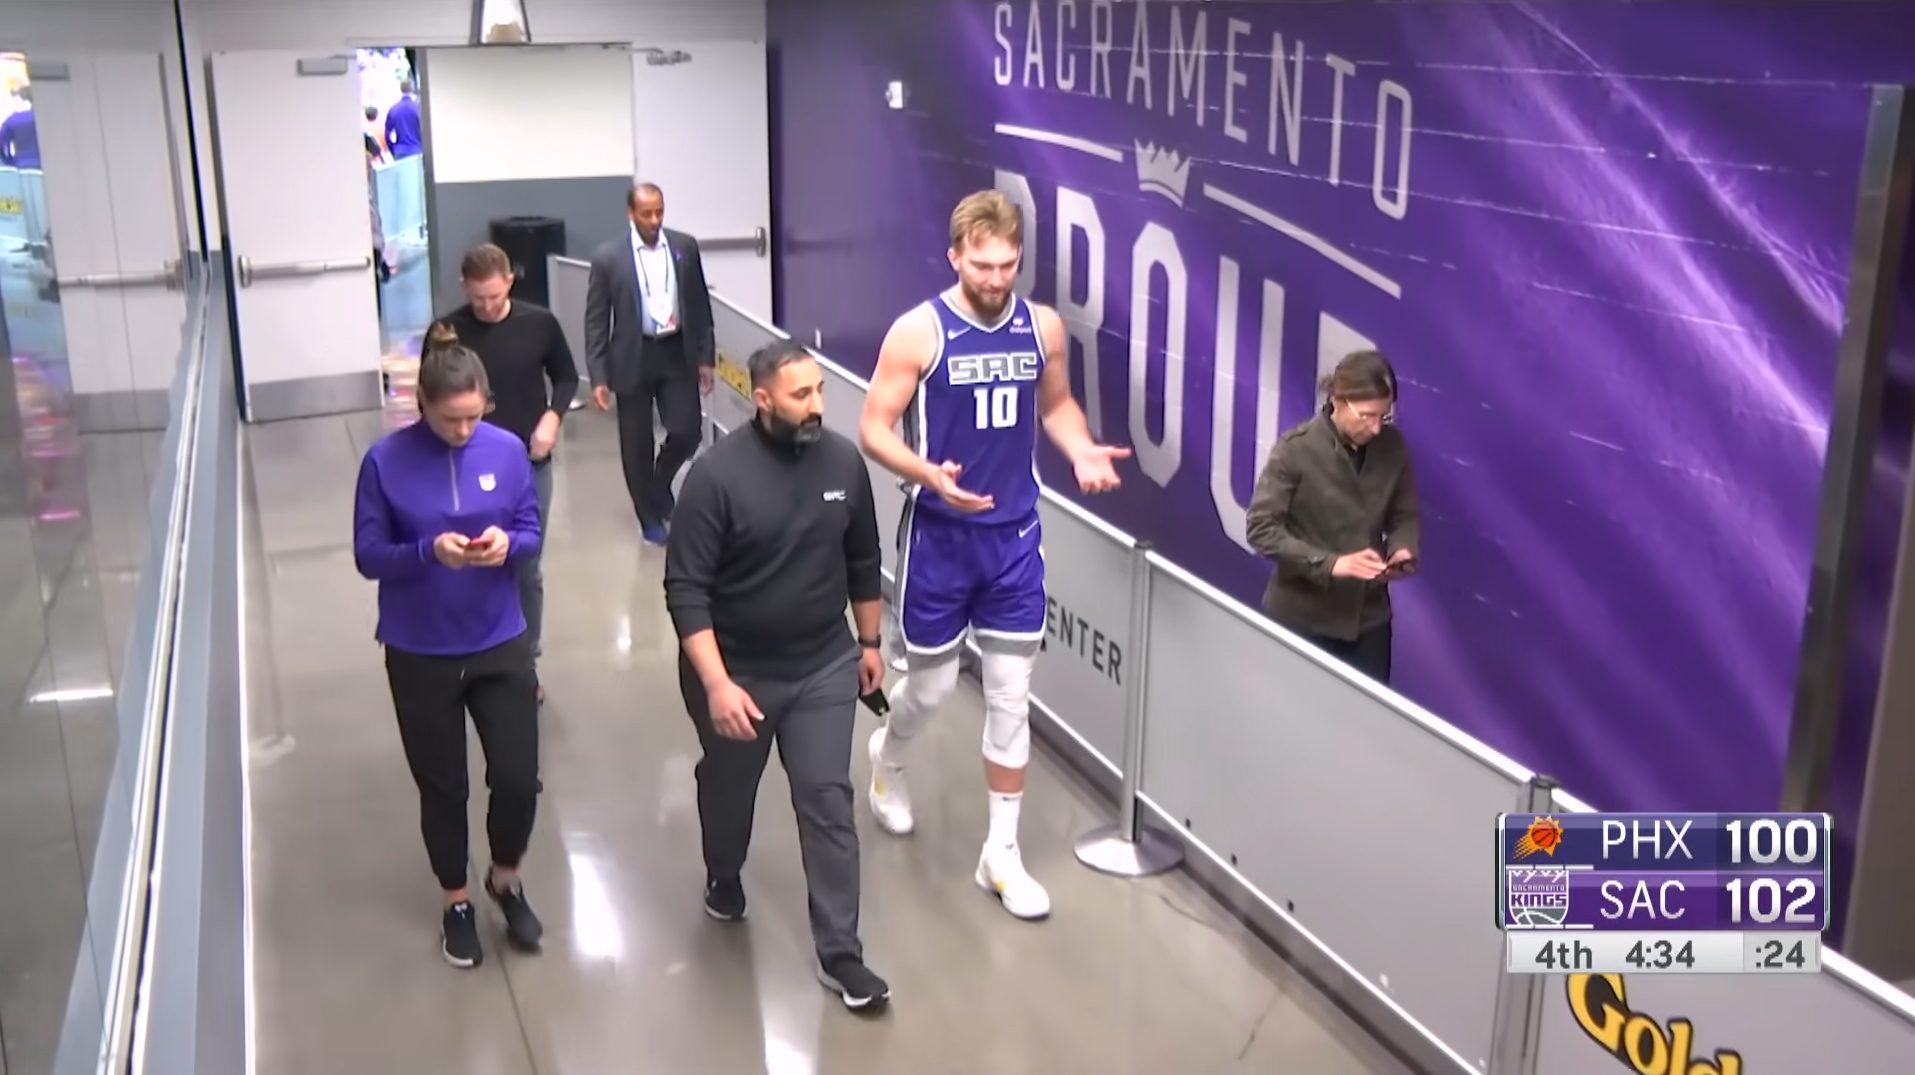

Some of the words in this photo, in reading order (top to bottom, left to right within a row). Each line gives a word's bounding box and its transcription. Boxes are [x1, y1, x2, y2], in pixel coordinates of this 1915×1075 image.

[994, 0, 1413, 220] SACRAMENTO
[948, 352, 1037, 386] SAC
[973, 386, 1018, 429] 10
